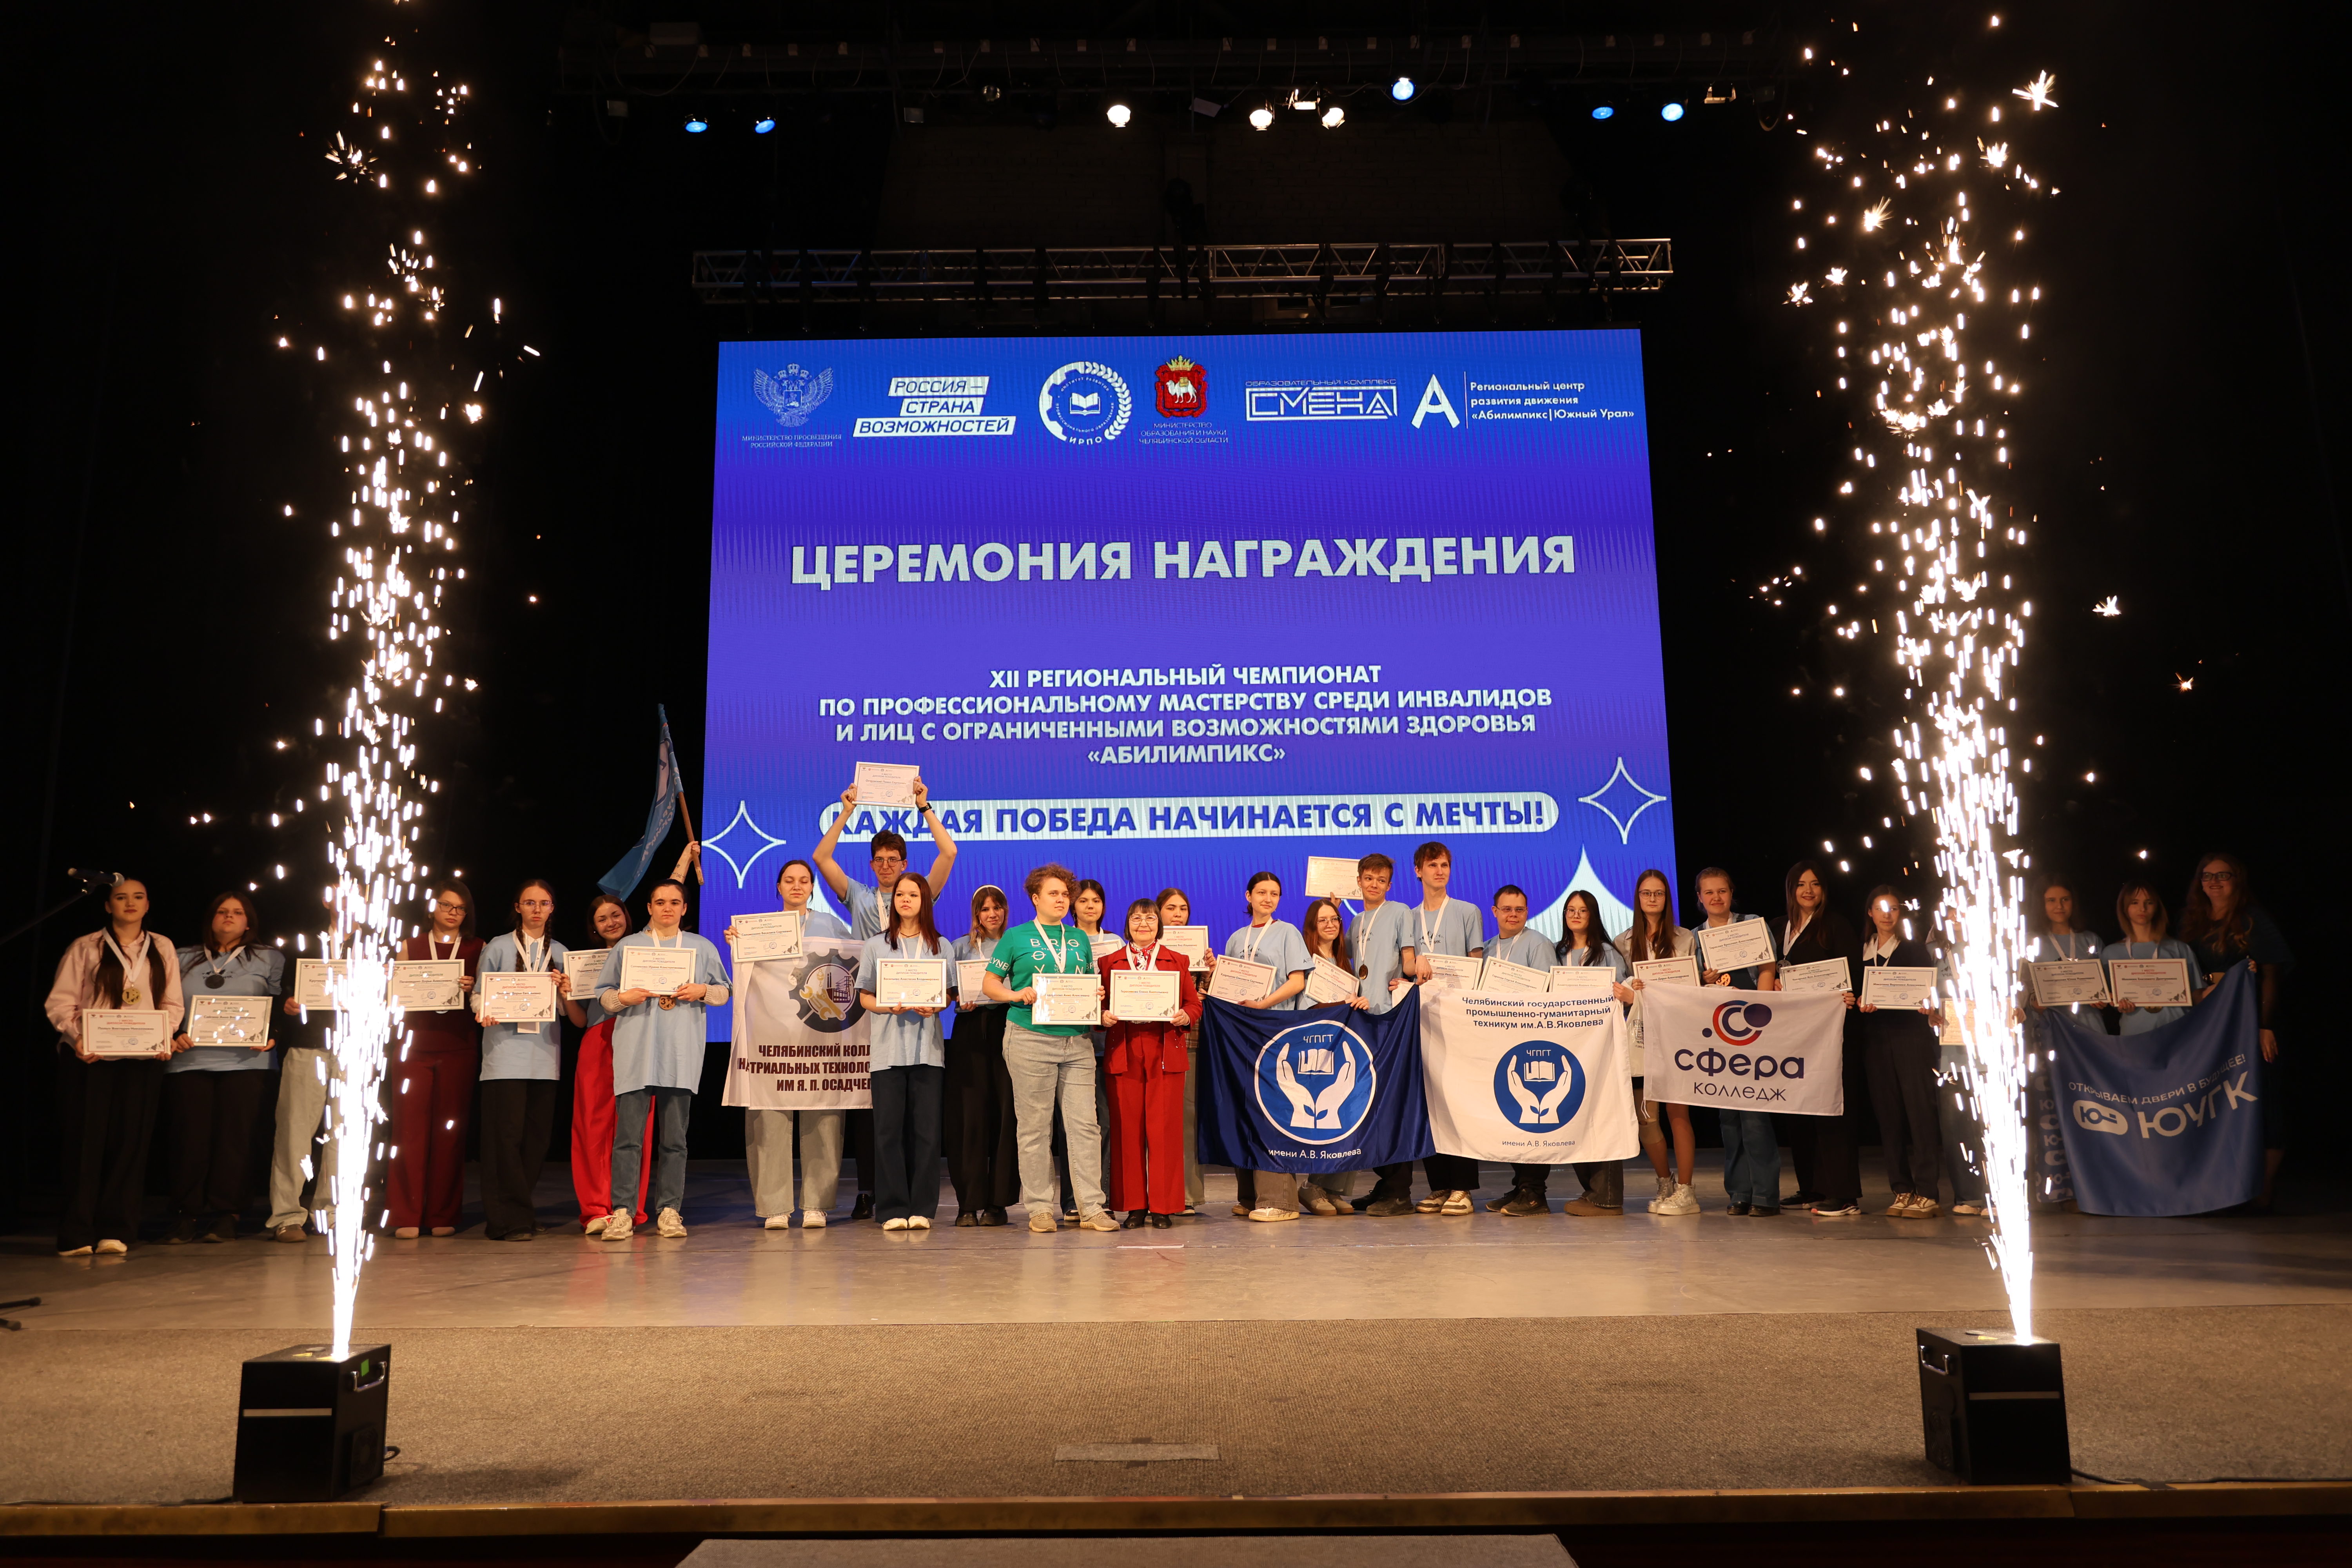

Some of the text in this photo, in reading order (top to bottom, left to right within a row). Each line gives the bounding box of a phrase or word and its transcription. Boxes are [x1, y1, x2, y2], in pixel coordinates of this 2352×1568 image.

[895, 381, 966, 393] РОССИЯ
[1470, 381, 1585, 392] Региональный центр
[906, 401, 975, 414] СТРАНА
[1251, 387, 1393, 416] СМЕНА
[1471, 396, 1579, 407] развития движения
[1599, 409, 1634, 420] Урал»
[859, 417, 1010, 434] ВОЗМОЖНОСТЕЙ
[1069, 436, 1103, 446] ИРПО
[792, 536, 1575, 591] ЦЕРЕМОНИЯ НАГРАЖДЕНИЯ
[990, 664, 1381, 688] XII РЕГИОНАЛЬНЫЙ ЧЕМПИОНАТ
[821, 689, 1552, 717] ПО ПРОФЕССИОНАЛЬНОМУ МАСТЕРСТВУ СРЕДИ ИНВАЛИДОВ
[837, 715, 1535, 744] И ЛИЦ С ОГРАНИЧЕННЫМИ ВОЗМОЖНОСТЯМИ ЗДОРОВЬЯ
[1089, 744, 1285, 764] «АБИЛИМПИКС»
[997, 807, 1137, 836] ПОБЕДА
[1149, 803, 1372, 831] НАЧИНАЕТСЯ
[1385, 802, 1404, 828] С
[1416, 801, 1544, 827] МЕЧТЫ!
[1462, 995, 1614, 1009] Челябинский государственный
[1466, 1006, 1611, 1020] промышленно-гуманитарный
[1473, 1019, 1604, 1030] техникум им.А.В.Яковлева
[1303, 1034, 1334, 1044] ЧГПГТ
[759, 1043, 840, 1057] ЧЕЛЯБИНСКИЙ
[1674, 1047, 1804, 1081] сфера
[777, 1079, 795, 1091] ИМ
[797, 1079, 808, 1091] Я.
[810, 1079, 819, 1091] П.
[1694, 1082, 1787, 1102] колледж
[2068, 1082, 2138, 1105] ОТКРЫВАЕМ
[2141, 1087, 2185, 1105] ДВЕРИ
[2187, 1082, 2197, 1093] В
[2136, 1071, 2258, 1139] ЮУГК
[1268, 1148, 1362, 1159] имени А.В. Яковлева
